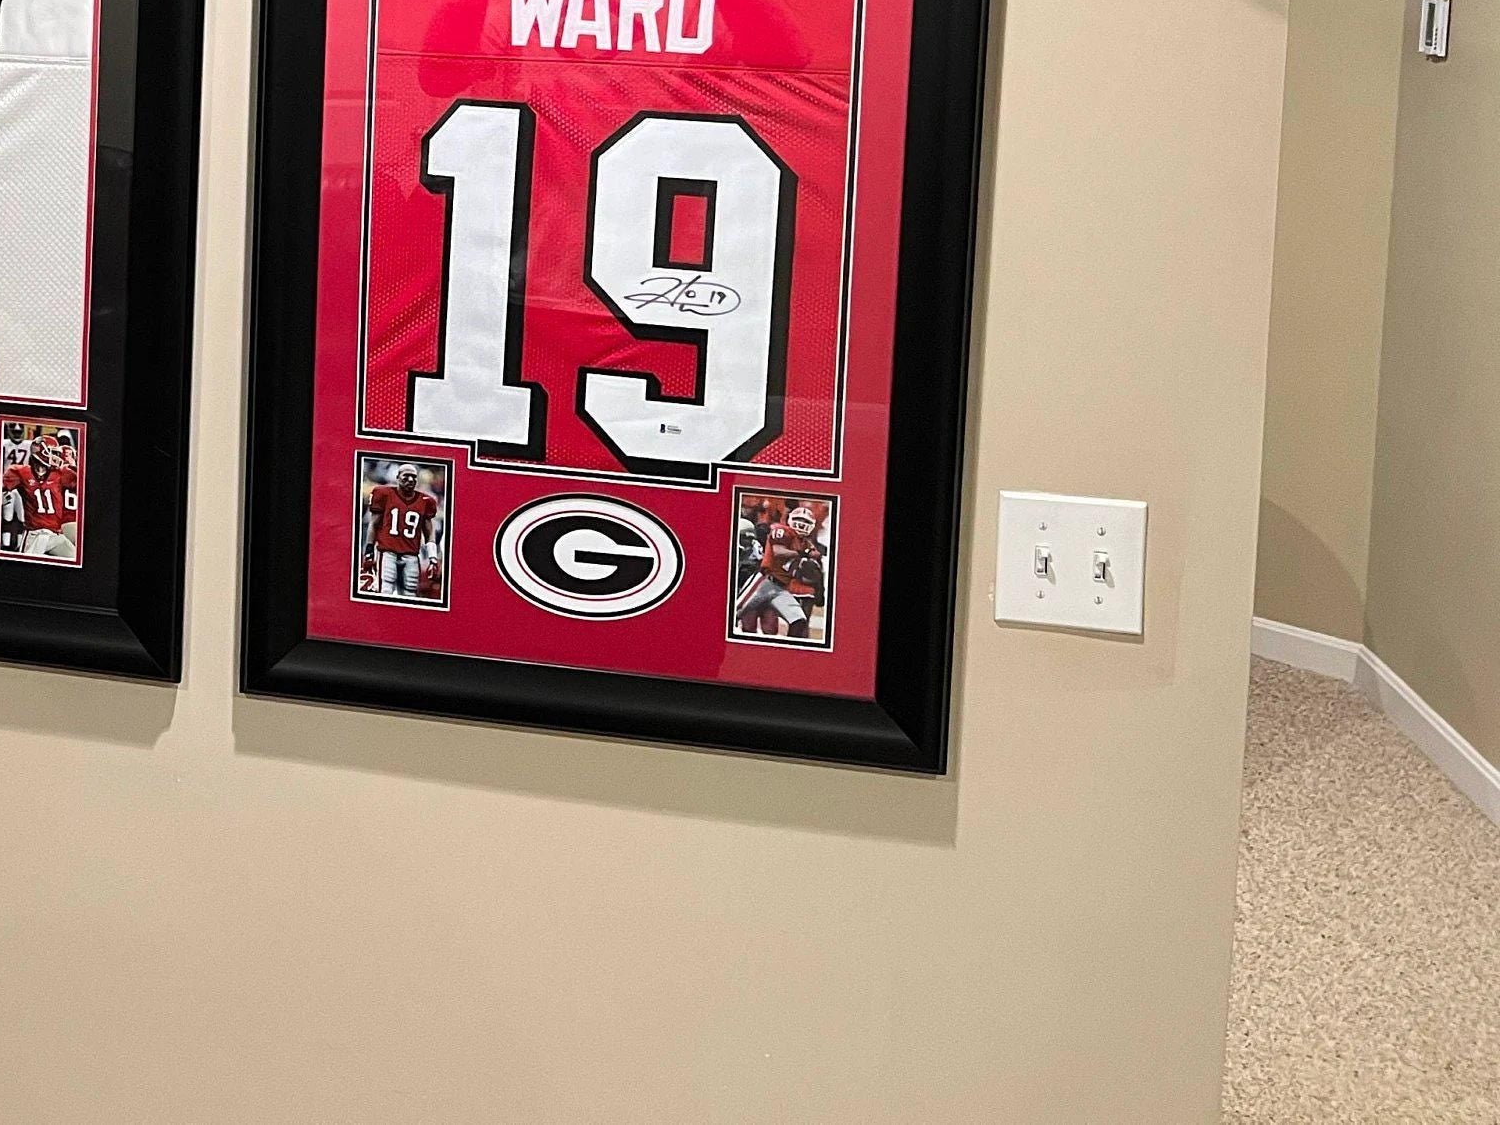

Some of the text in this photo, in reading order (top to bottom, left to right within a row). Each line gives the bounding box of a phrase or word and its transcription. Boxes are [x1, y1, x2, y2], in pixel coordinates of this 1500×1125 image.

[406, 97, 799, 475] 19
[33, 488, 56, 515] 11
[389, 507, 421, 539] 19
[520, 514, 657, 596] G
